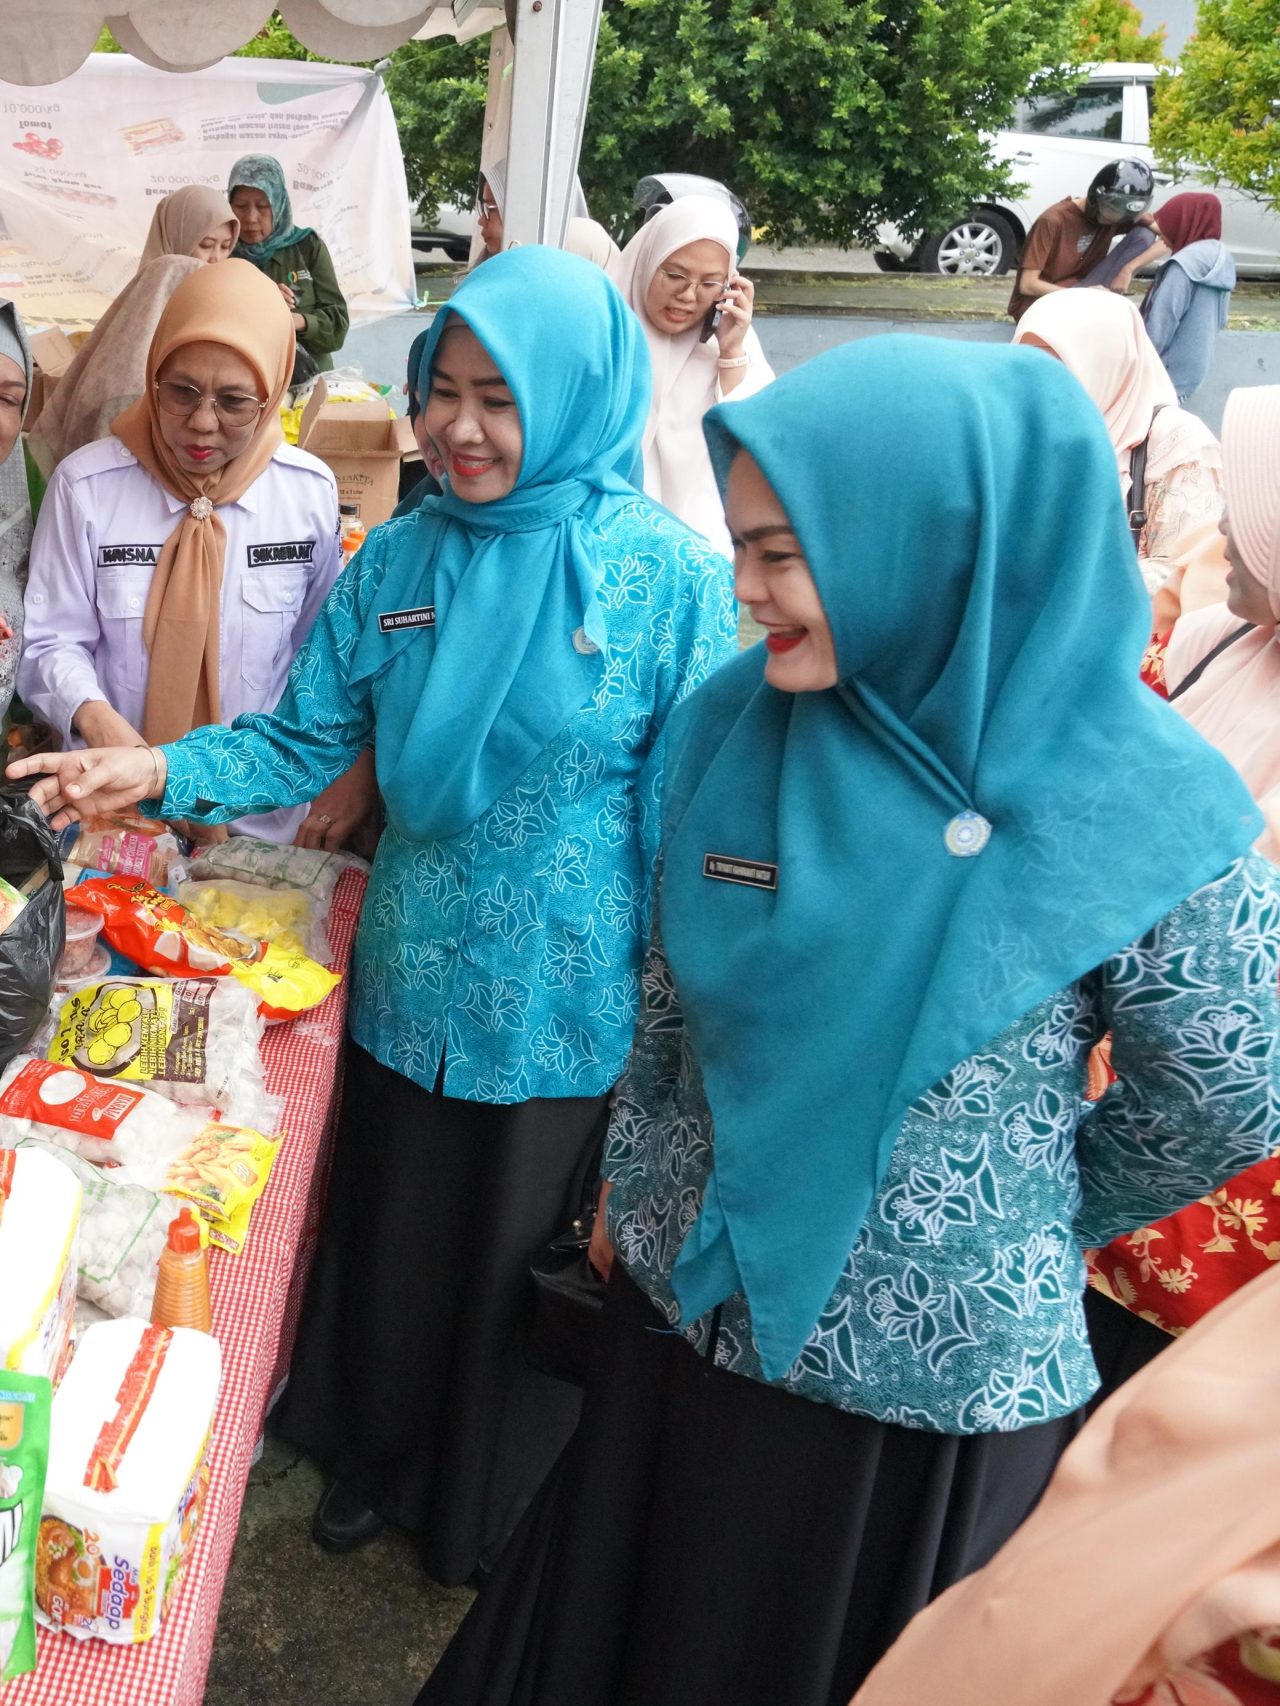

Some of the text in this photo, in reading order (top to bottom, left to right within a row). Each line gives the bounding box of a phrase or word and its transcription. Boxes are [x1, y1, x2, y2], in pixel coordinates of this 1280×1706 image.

[383, 612, 431, 627] SRI SUHARTINI
[139, 1044, 149, 1074] LEBIH
[149, 1045, 158, 1075] LEBIH
[157, 1045, 167, 1075] LEBIH
[82, 1527, 100, 1556] 20
[130, 1566, 139, 1584] Mie
[105, 1555, 130, 1631] Sedaap
